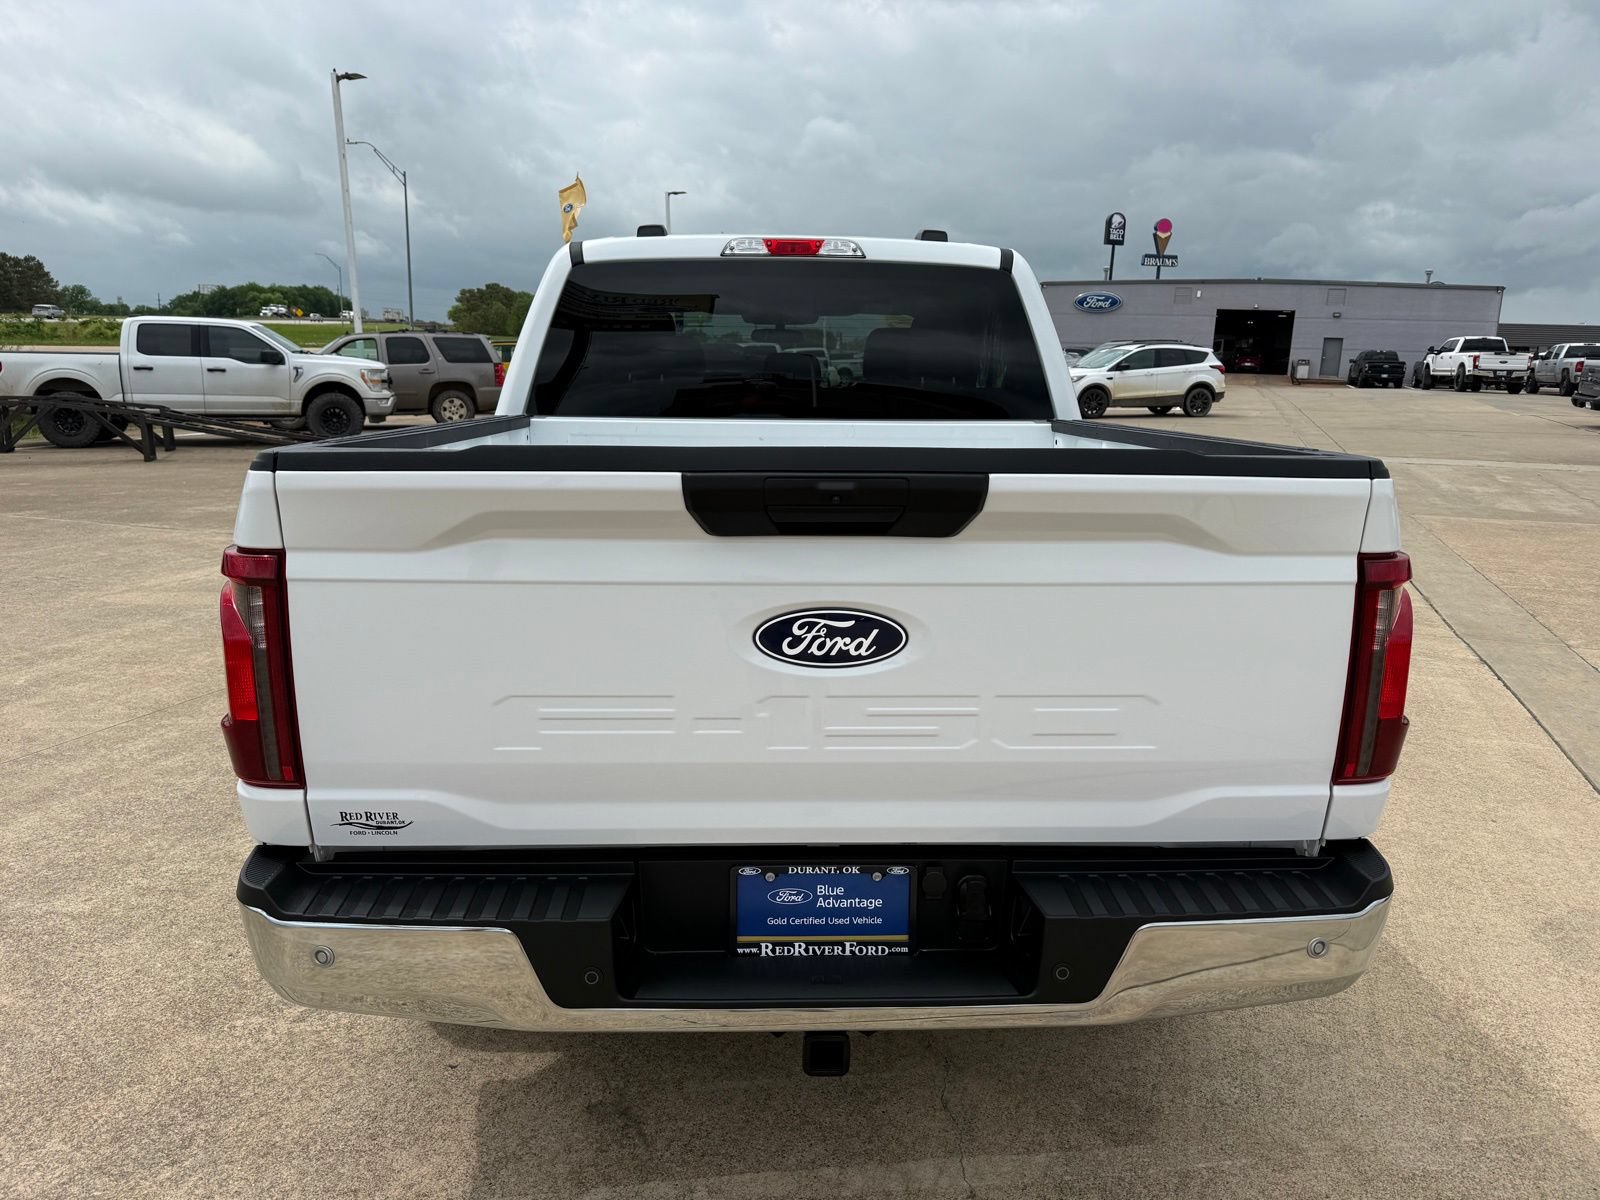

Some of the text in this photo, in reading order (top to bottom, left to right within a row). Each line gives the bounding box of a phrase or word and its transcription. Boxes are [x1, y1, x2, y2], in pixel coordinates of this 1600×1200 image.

[1144, 257, 1178, 266] BRAUM'S
[1083, 295, 1112, 309] Ford
[781, 618, 879, 658] Ford
[339, 811, 399, 821] RED RIVER
[788, 866, 860, 875] DURANT, OK
[776, 890, 804, 902] Ford
[817, 885, 844, 896] Blue
[816, 897, 883, 910] Advantage
[767, 916, 883, 925] Gold Certified Used Vehicle
